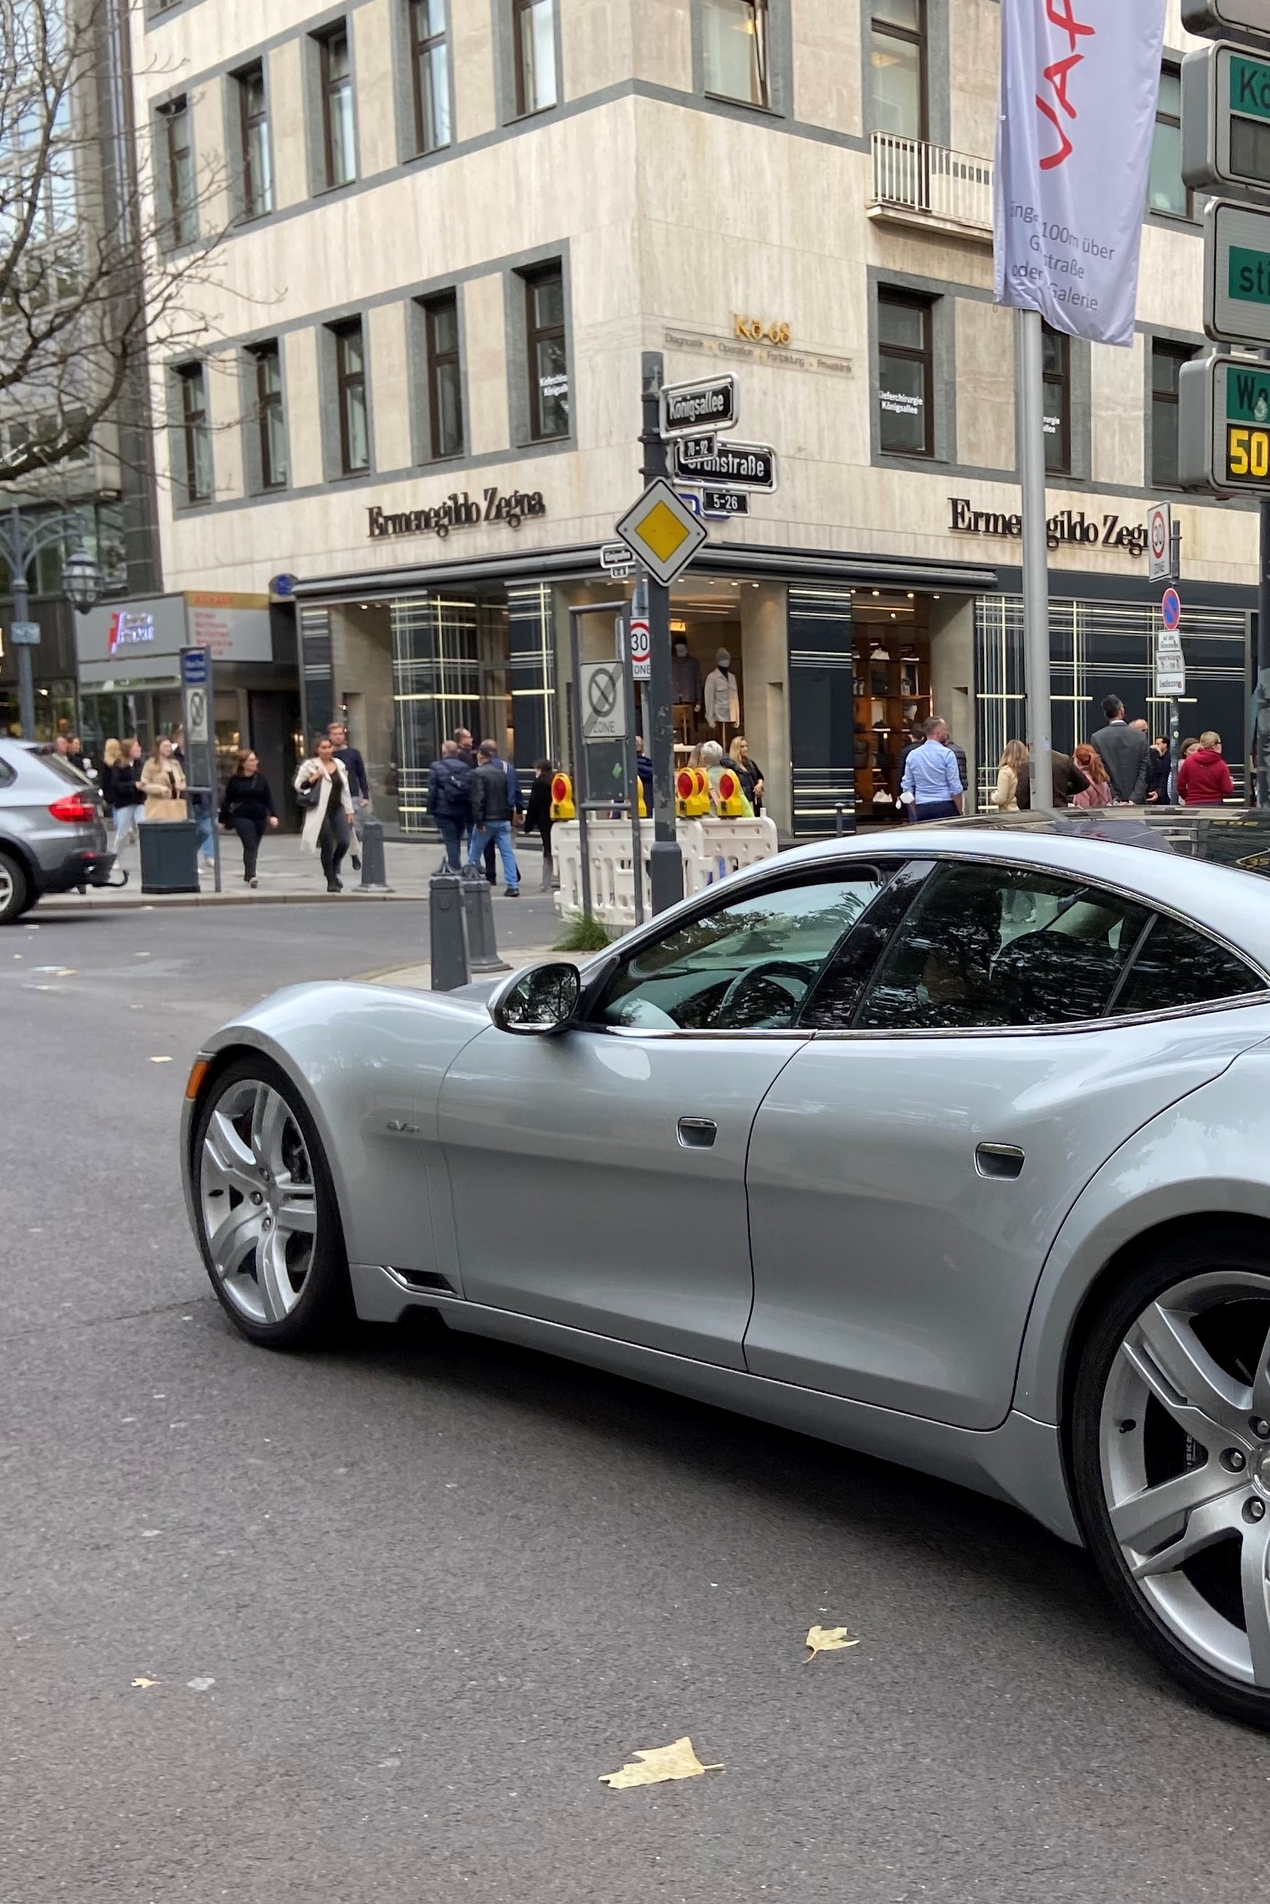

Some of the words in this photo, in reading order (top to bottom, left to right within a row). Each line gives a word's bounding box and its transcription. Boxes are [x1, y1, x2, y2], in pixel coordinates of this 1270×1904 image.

[1042, 222, 1078, 249] 100m
[1082, 237, 1115, 260] über
[1012, 261, 1043, 280] oder
[732, 313, 792, 345] Kö-68
[668, 391, 724, 422] Königsallee
[366, 492, 482, 538] Ermenegildo
[483, 487, 547, 530] Zegna
[713, 493, 739, 510] 5-26
[948, 497, 1099, 549] Ermegildo
[631, 633, 648, 651] 30
[634, 664, 651, 675] ONE
